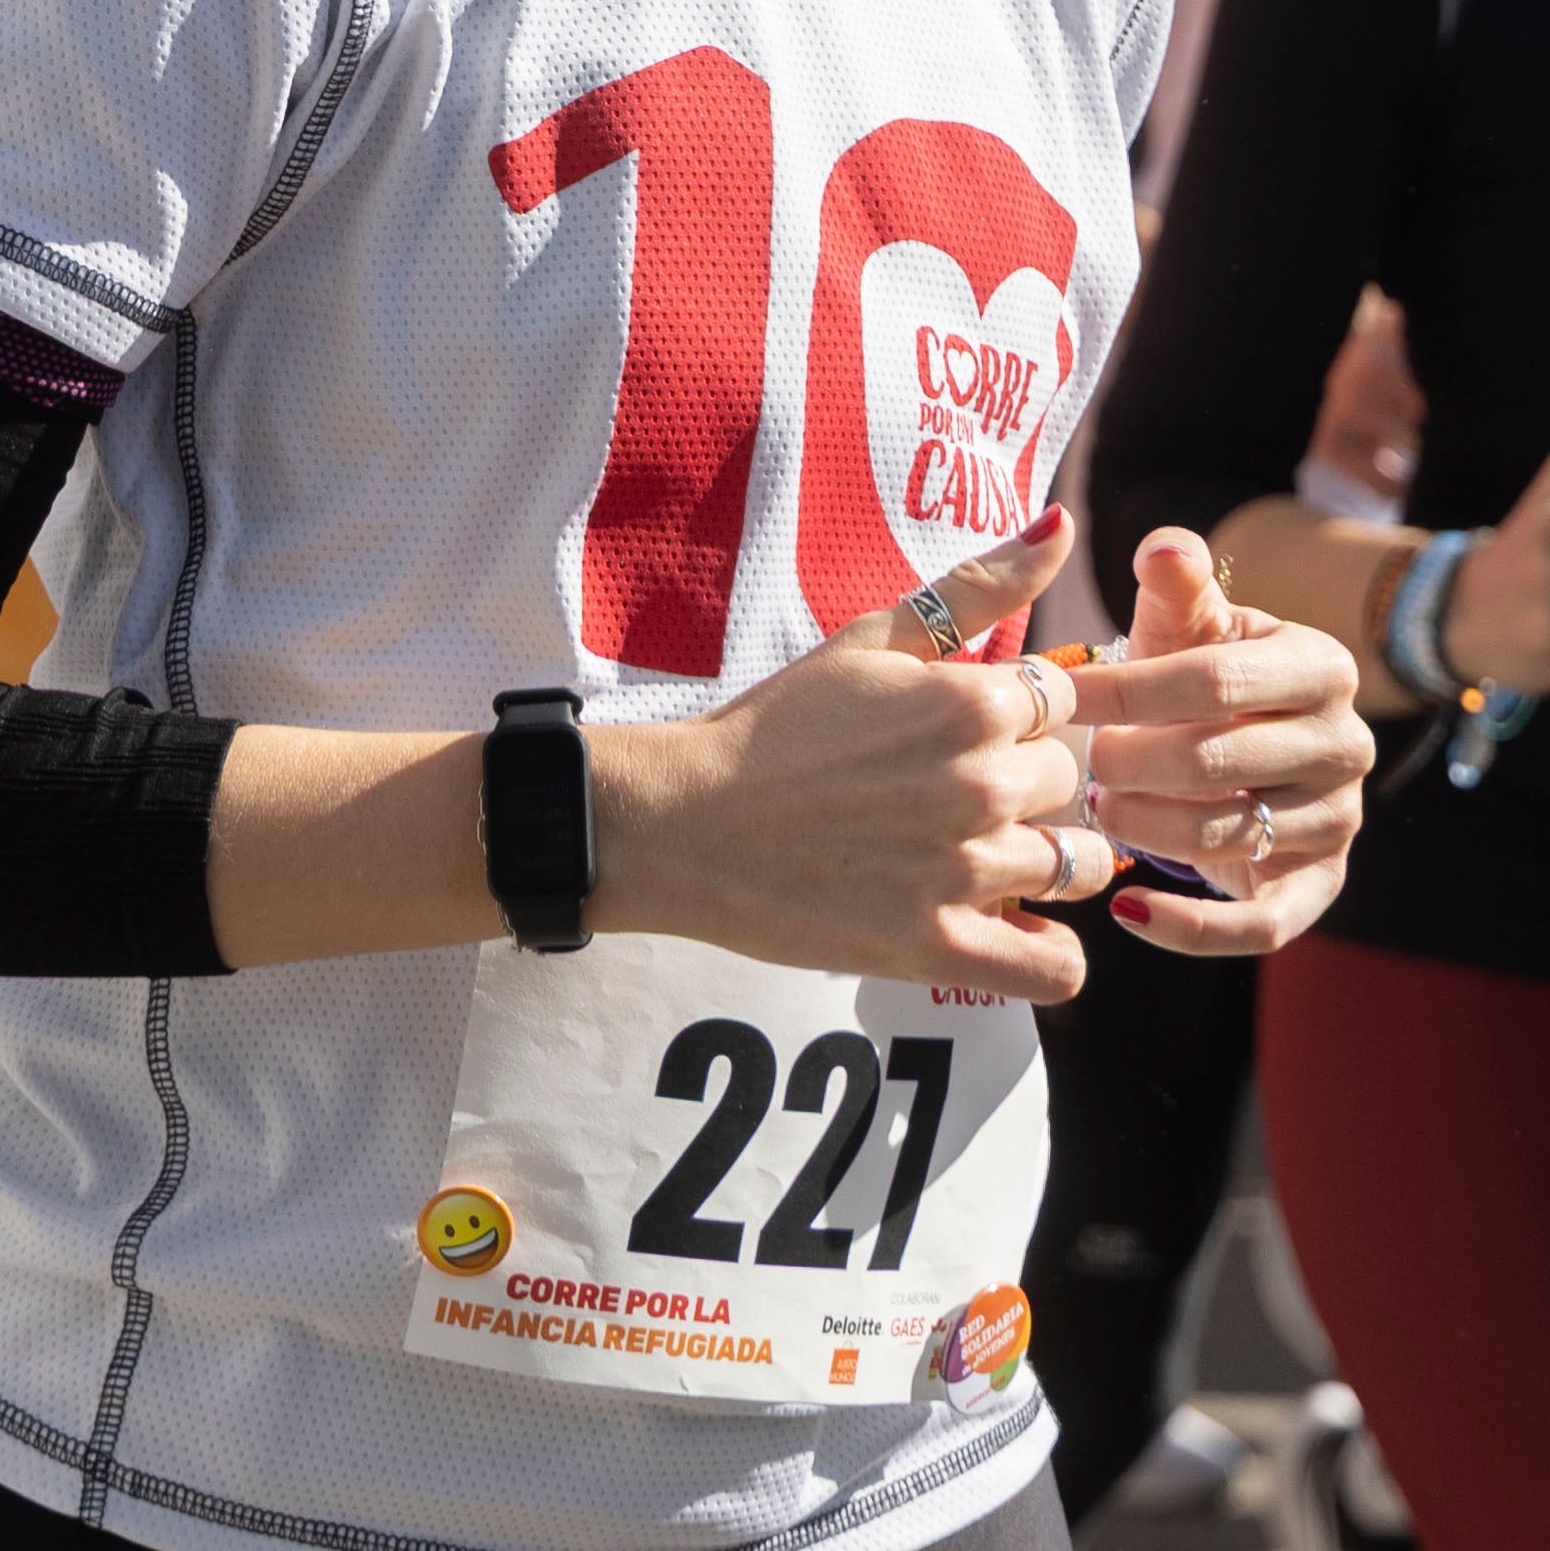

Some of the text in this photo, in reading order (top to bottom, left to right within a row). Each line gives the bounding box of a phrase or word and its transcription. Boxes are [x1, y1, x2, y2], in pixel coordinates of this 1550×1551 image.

[916, 325, 1039, 441] CORRE
[919, 402, 955, 444] POR
[904, 438, 1021, 537] CAUSA
[506, 1273, 731, 1325] CORRE POR LA
[435, 1296, 774, 1364] INFANCIA REFUGIADA
[822, 1315, 882, 1336] Deloitte
[891, 1316, 926, 1337] GAES
[959, 1314, 986, 1344] RED
[961, 1301, 1025, 1361] SOLIDARIA
